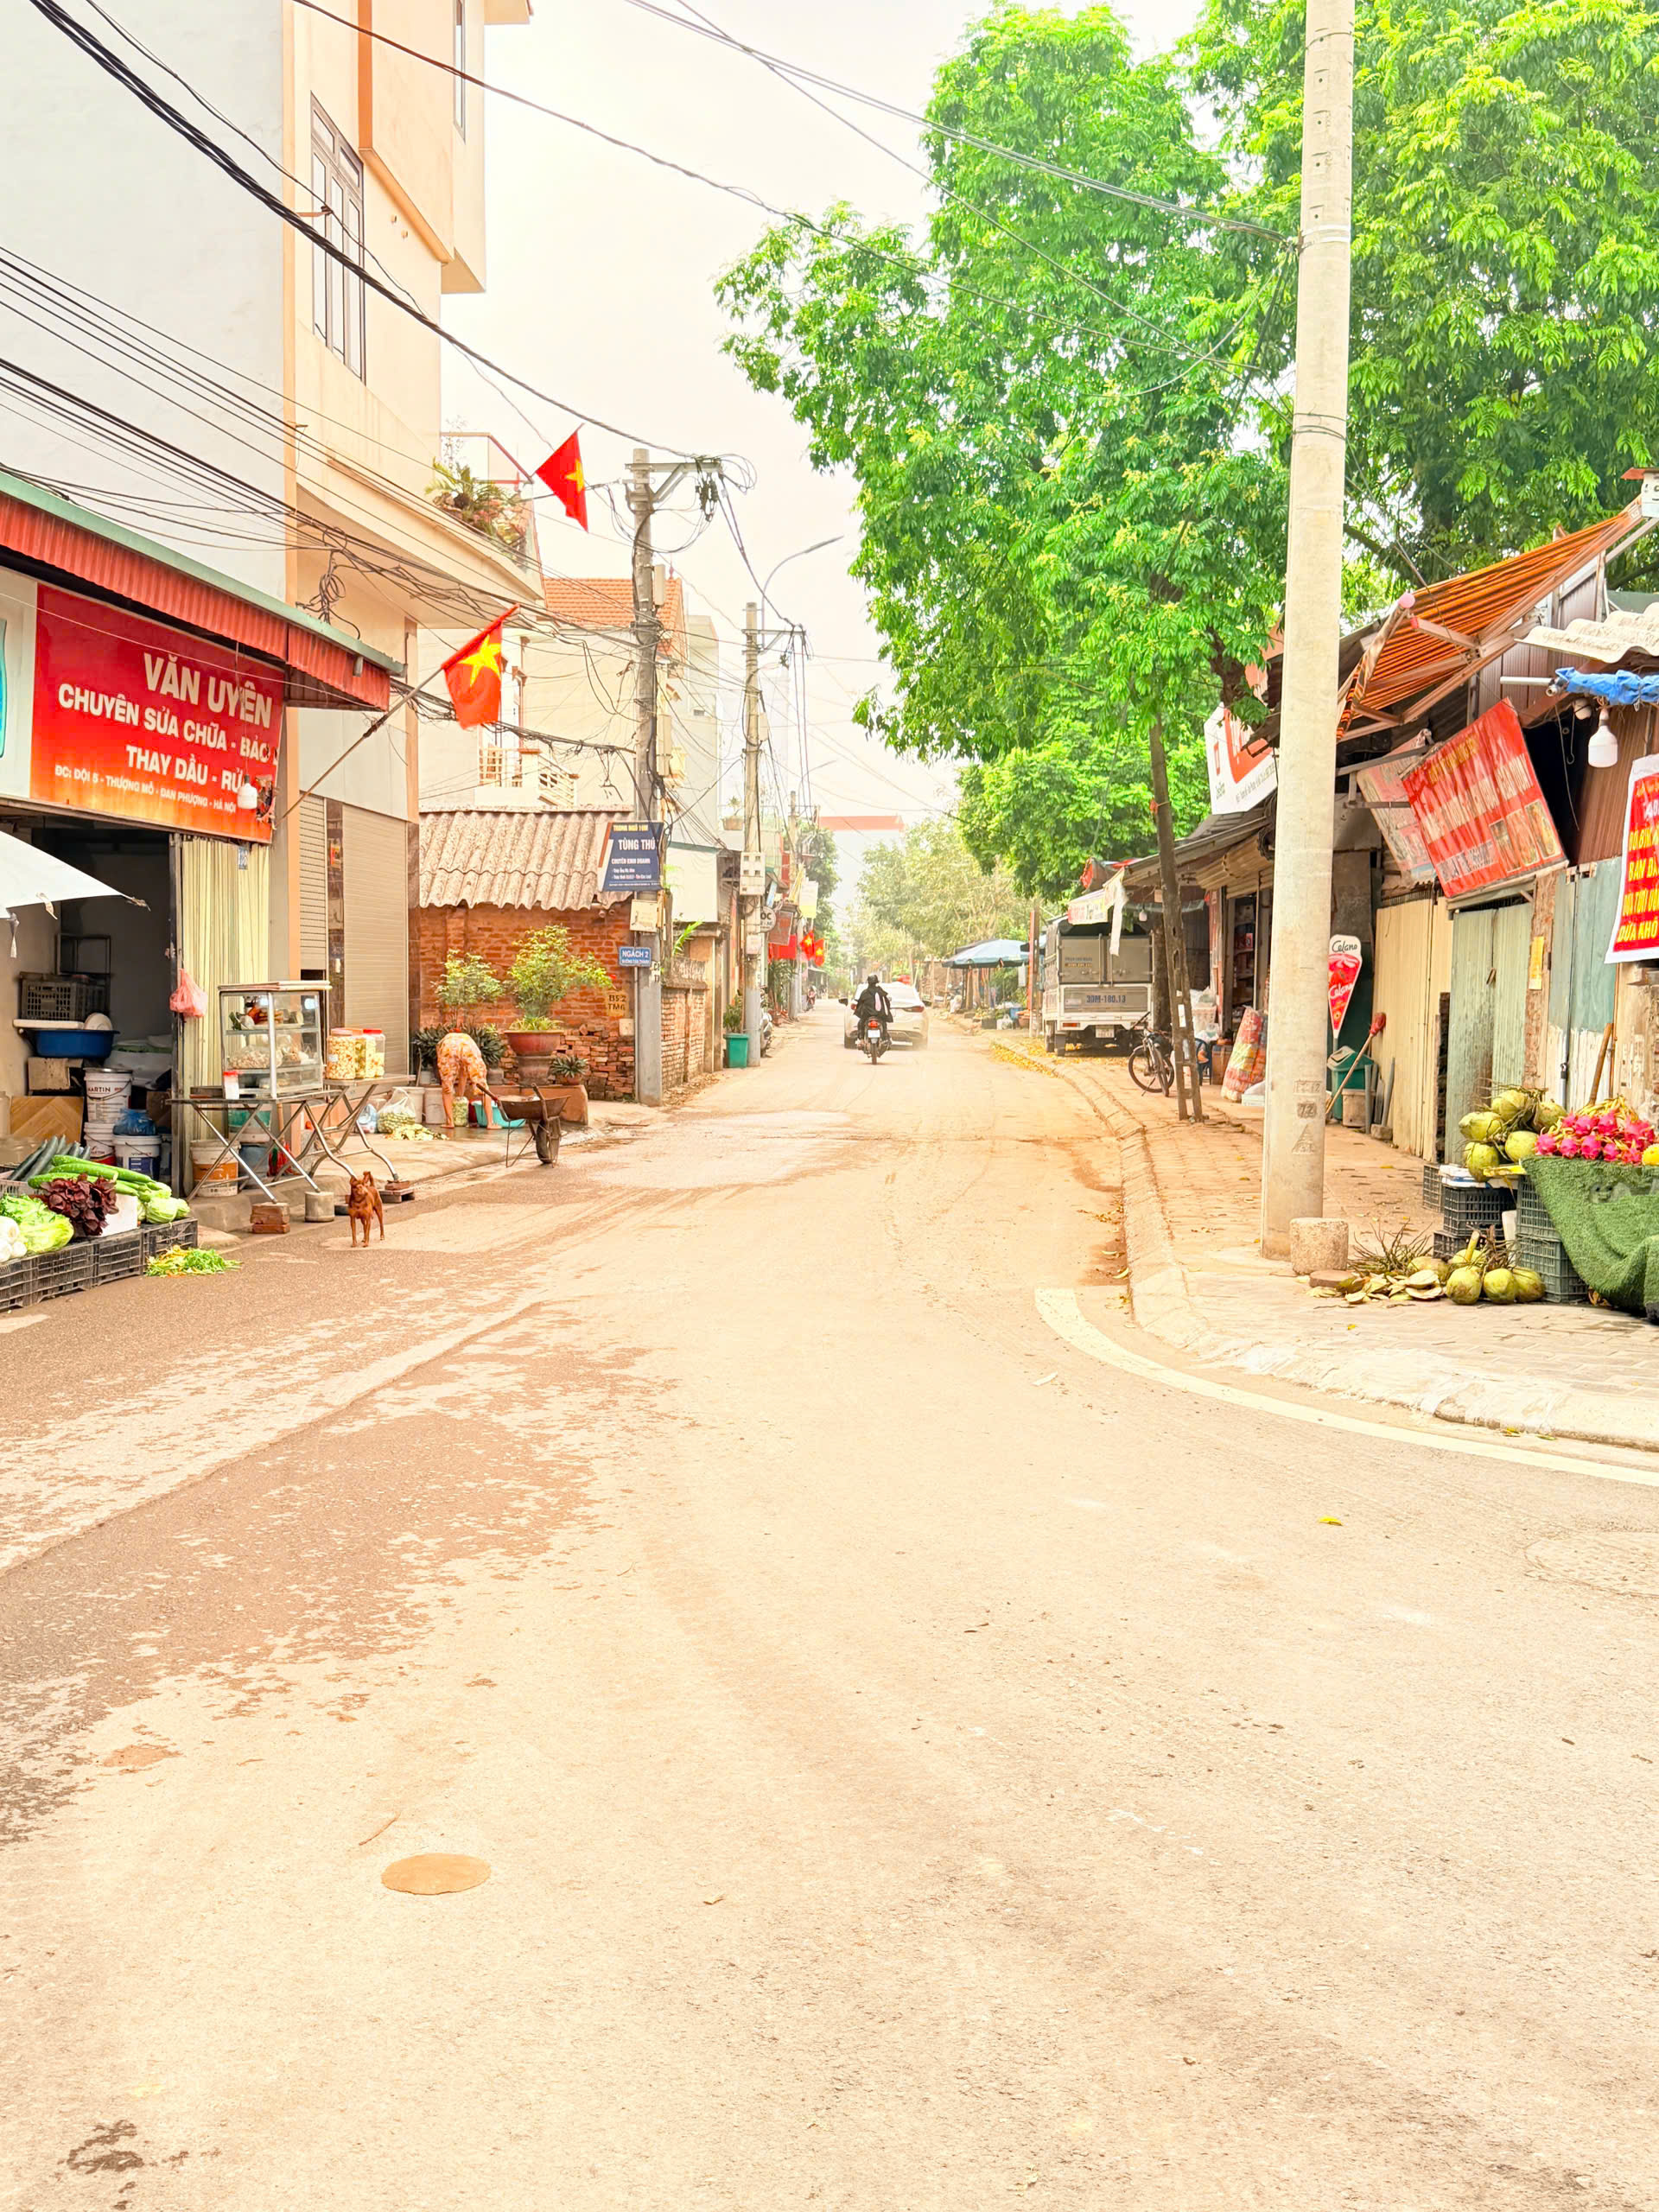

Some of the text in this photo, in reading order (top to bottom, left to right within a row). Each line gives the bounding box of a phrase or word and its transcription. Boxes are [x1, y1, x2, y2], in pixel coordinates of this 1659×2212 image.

[143, 652, 273, 728] VĂN UYÊN
[58, 683, 140, 726] CHUYÊN
[143, 705, 179, 738] SỬA
[183, 720, 227, 751] CHỮA
[54, 764, 72, 778] ĐC:
[73, 766, 90, 785] ĐỘI
[177, 791, 208, 808] PHƯỢNG
[126, 744, 171, 776] THAY
[175, 753, 208, 785] DẦU
[221, 768, 245, 794] RỬ
[618, 836, 639, 850] TÙNG
[1332, 940, 1358, 954] Celano
